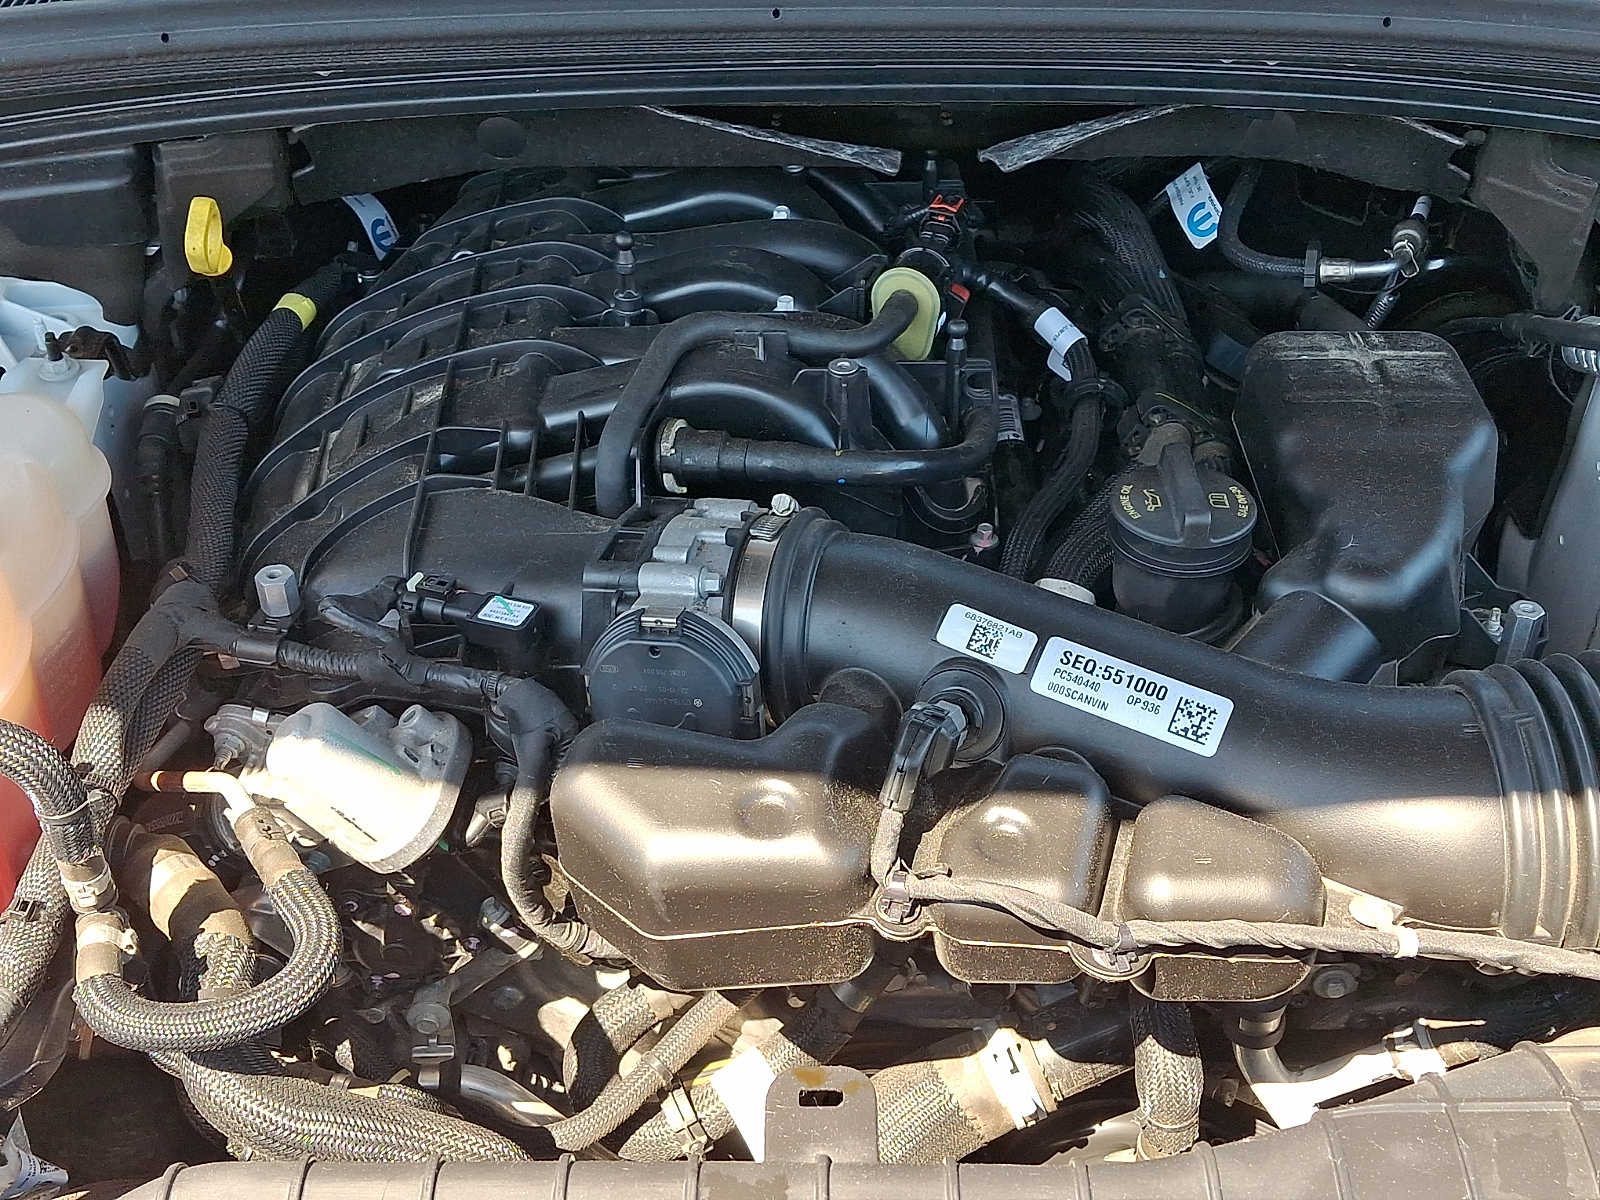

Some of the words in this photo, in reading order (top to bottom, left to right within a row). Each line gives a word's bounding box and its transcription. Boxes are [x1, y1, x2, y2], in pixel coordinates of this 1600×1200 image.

[1120, 484, 1134, 495] OIL
[1120, 494, 1142, 519] ENGINE
[964, 611, 1023, 639] 68376821AB
[1053, 667, 1101, 692] PC540440
[1060, 650, 1169, 701] SEQ:551000
